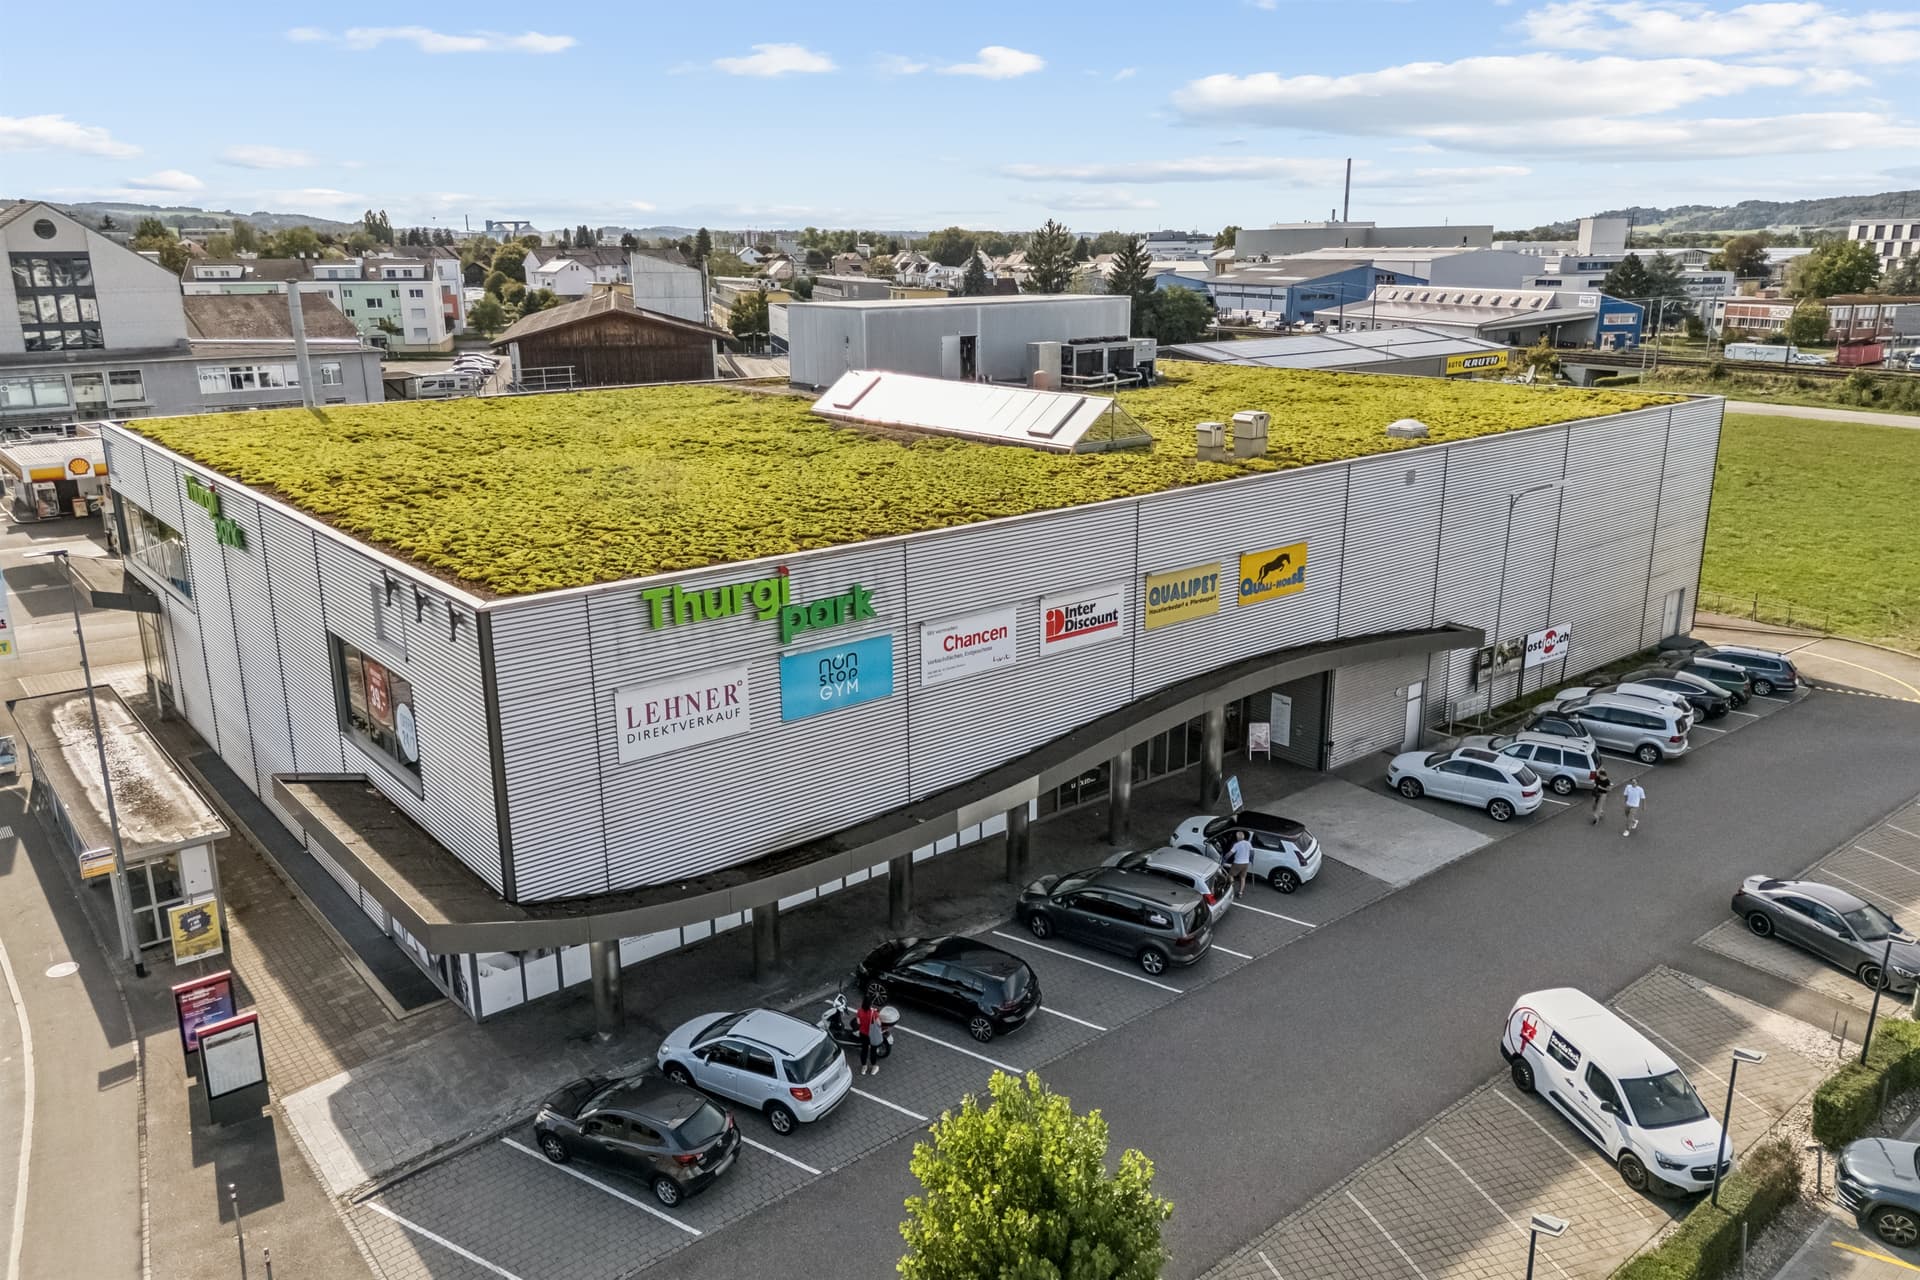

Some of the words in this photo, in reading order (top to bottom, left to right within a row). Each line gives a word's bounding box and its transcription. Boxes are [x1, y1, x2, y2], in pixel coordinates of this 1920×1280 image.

[1463, 356, 1498, 368] KAUTH
[641, 565, 791, 630] Thurgi
[1149, 573, 1218, 606] QUALIPET
[780, 582, 878, 645] park
[1065, 602, 1097, 619] Inter
[1065, 608, 1119, 632] Discount
[943, 626, 1008, 652] Chancen
[820, 668, 858, 686] stop
[820, 678, 859, 700] GYM
[627, 707, 742, 744] DIREKTVERKAUF
